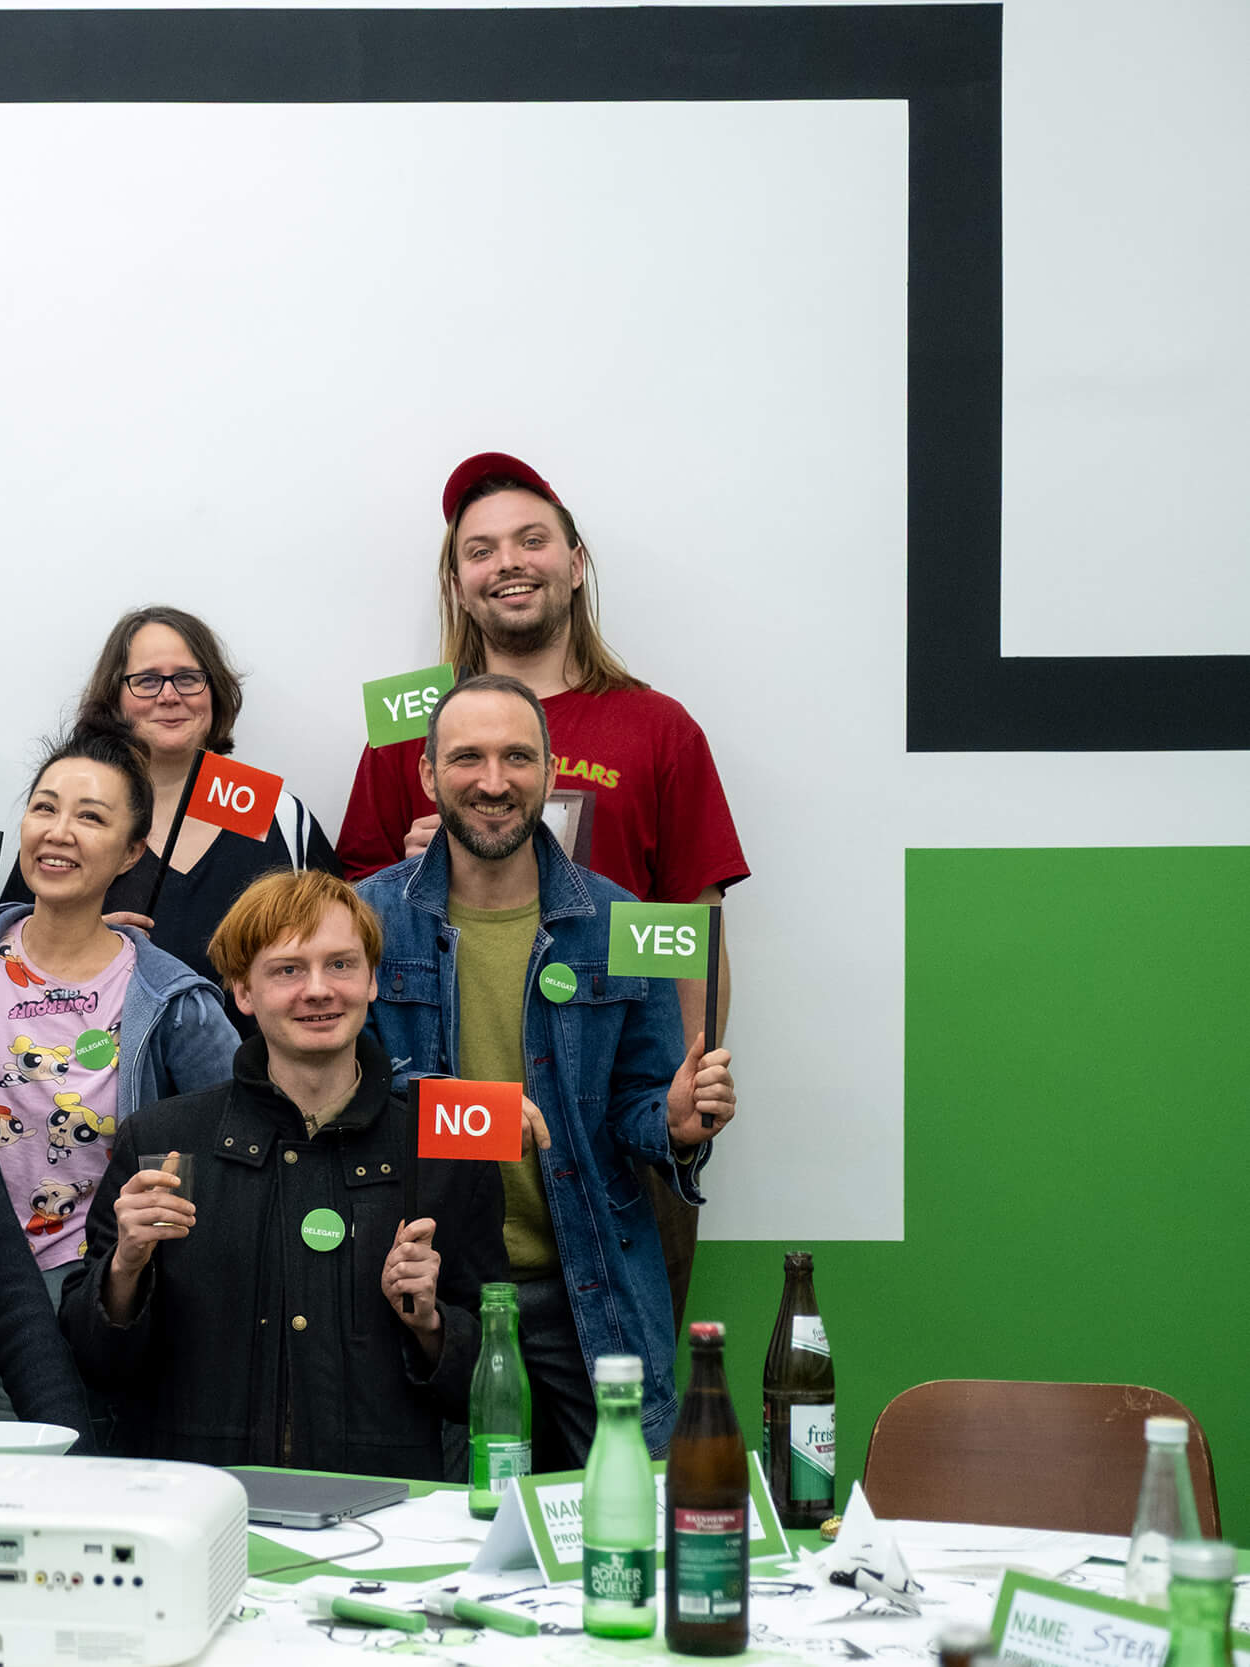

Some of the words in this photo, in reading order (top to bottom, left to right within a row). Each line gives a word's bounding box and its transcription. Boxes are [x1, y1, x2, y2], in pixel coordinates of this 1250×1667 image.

[383, 686, 440, 722] YES
[556, 755, 620, 788] LARS
[207, 776, 255, 813] NO
[630, 924, 697, 957] YES
[545, 976, 576, 993] DELEGATE
[76, 1038, 110, 1056] DELEGATE
[435, 1104, 491, 1136] NO
[303, 1226, 341, 1239] DELEGATE
[544, 1499, 583, 1520] NAM
[1011, 1610, 1074, 1646] NAME:
